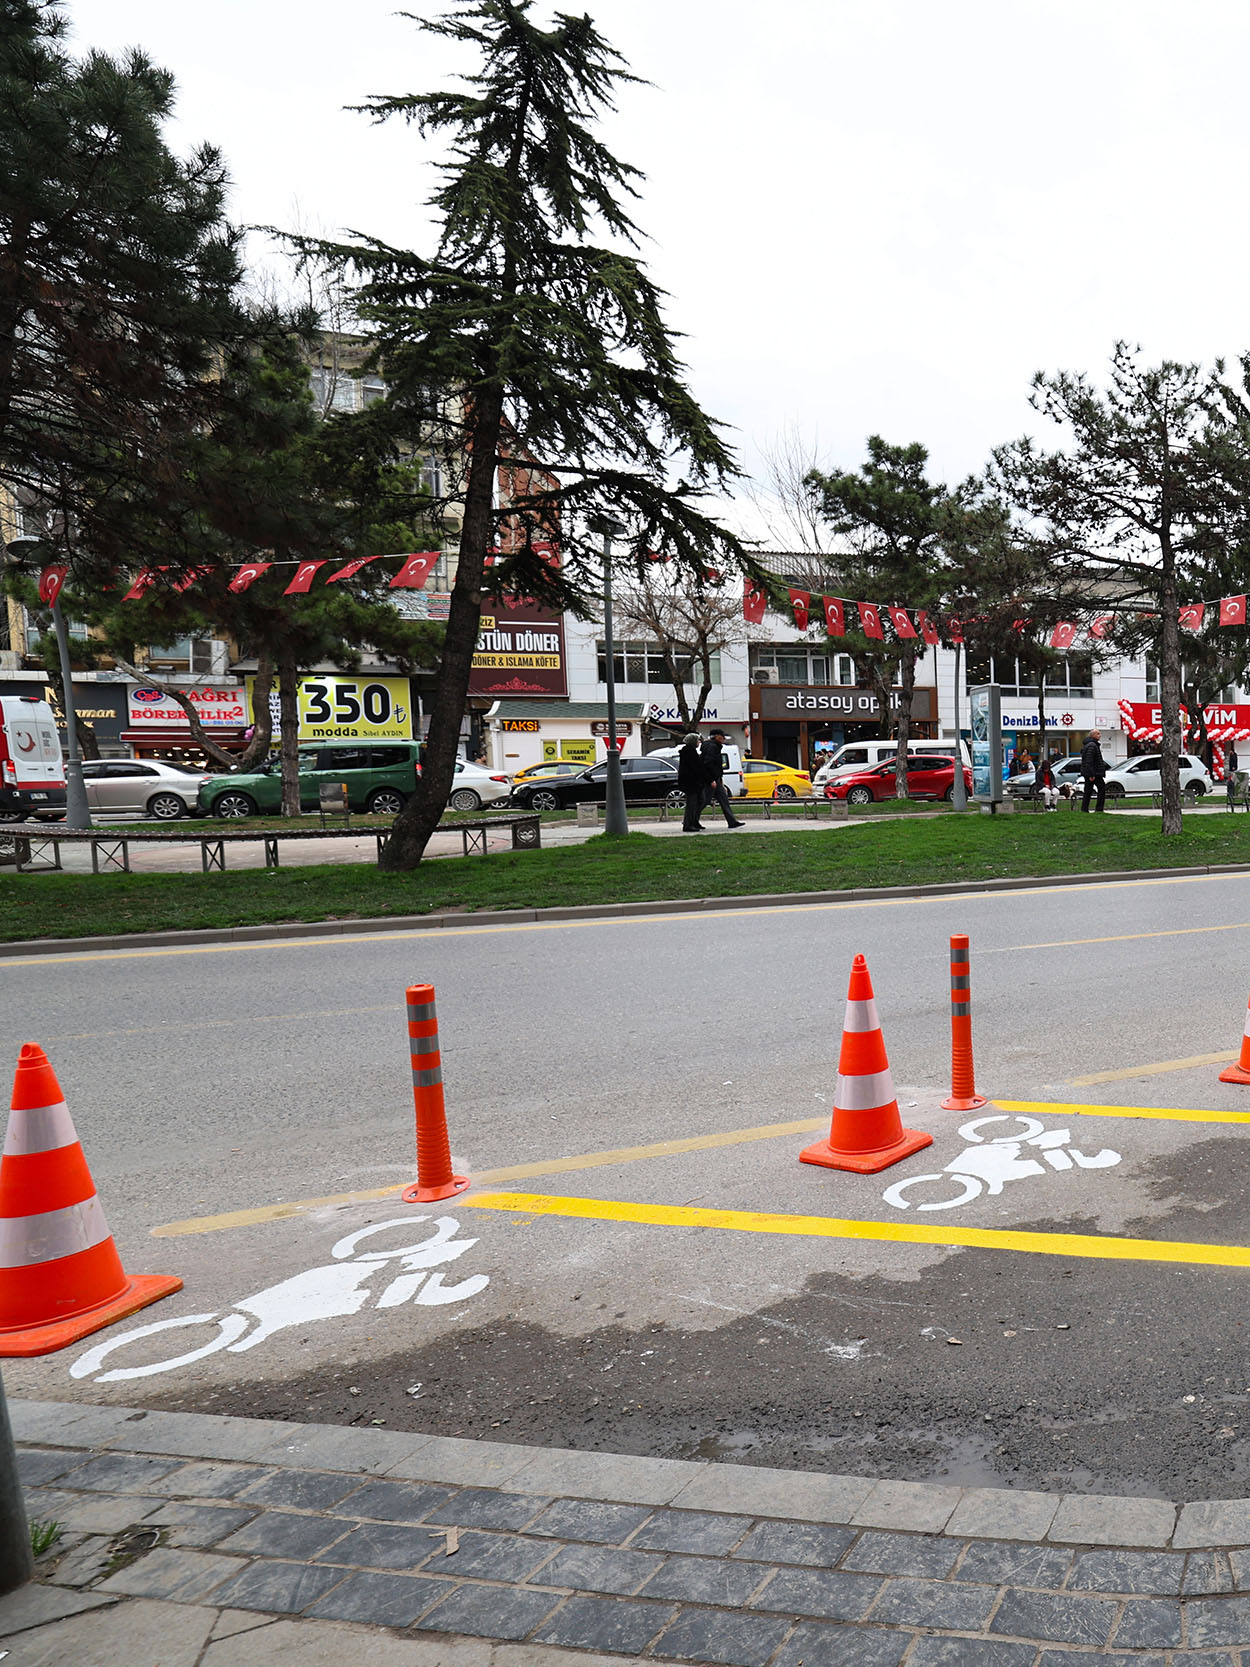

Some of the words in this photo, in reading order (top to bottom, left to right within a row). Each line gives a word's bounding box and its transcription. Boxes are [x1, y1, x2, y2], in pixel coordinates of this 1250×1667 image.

[476, 629, 512, 651] STÜN
[515, 630, 560, 652] DÖNER
[498, 656, 505, 667] &
[535, 656, 558, 668] KÖFTE
[179, 688, 239, 703] AĞRI
[786, 691, 853, 713] atasoy
[857, 692, 902, 713] opik
[1002, 715, 1058, 726] DenizBnk
[312, 727, 359, 737] modda
[363, 729, 379, 737] Sibel
[381, 729, 404, 737] AYDIN
